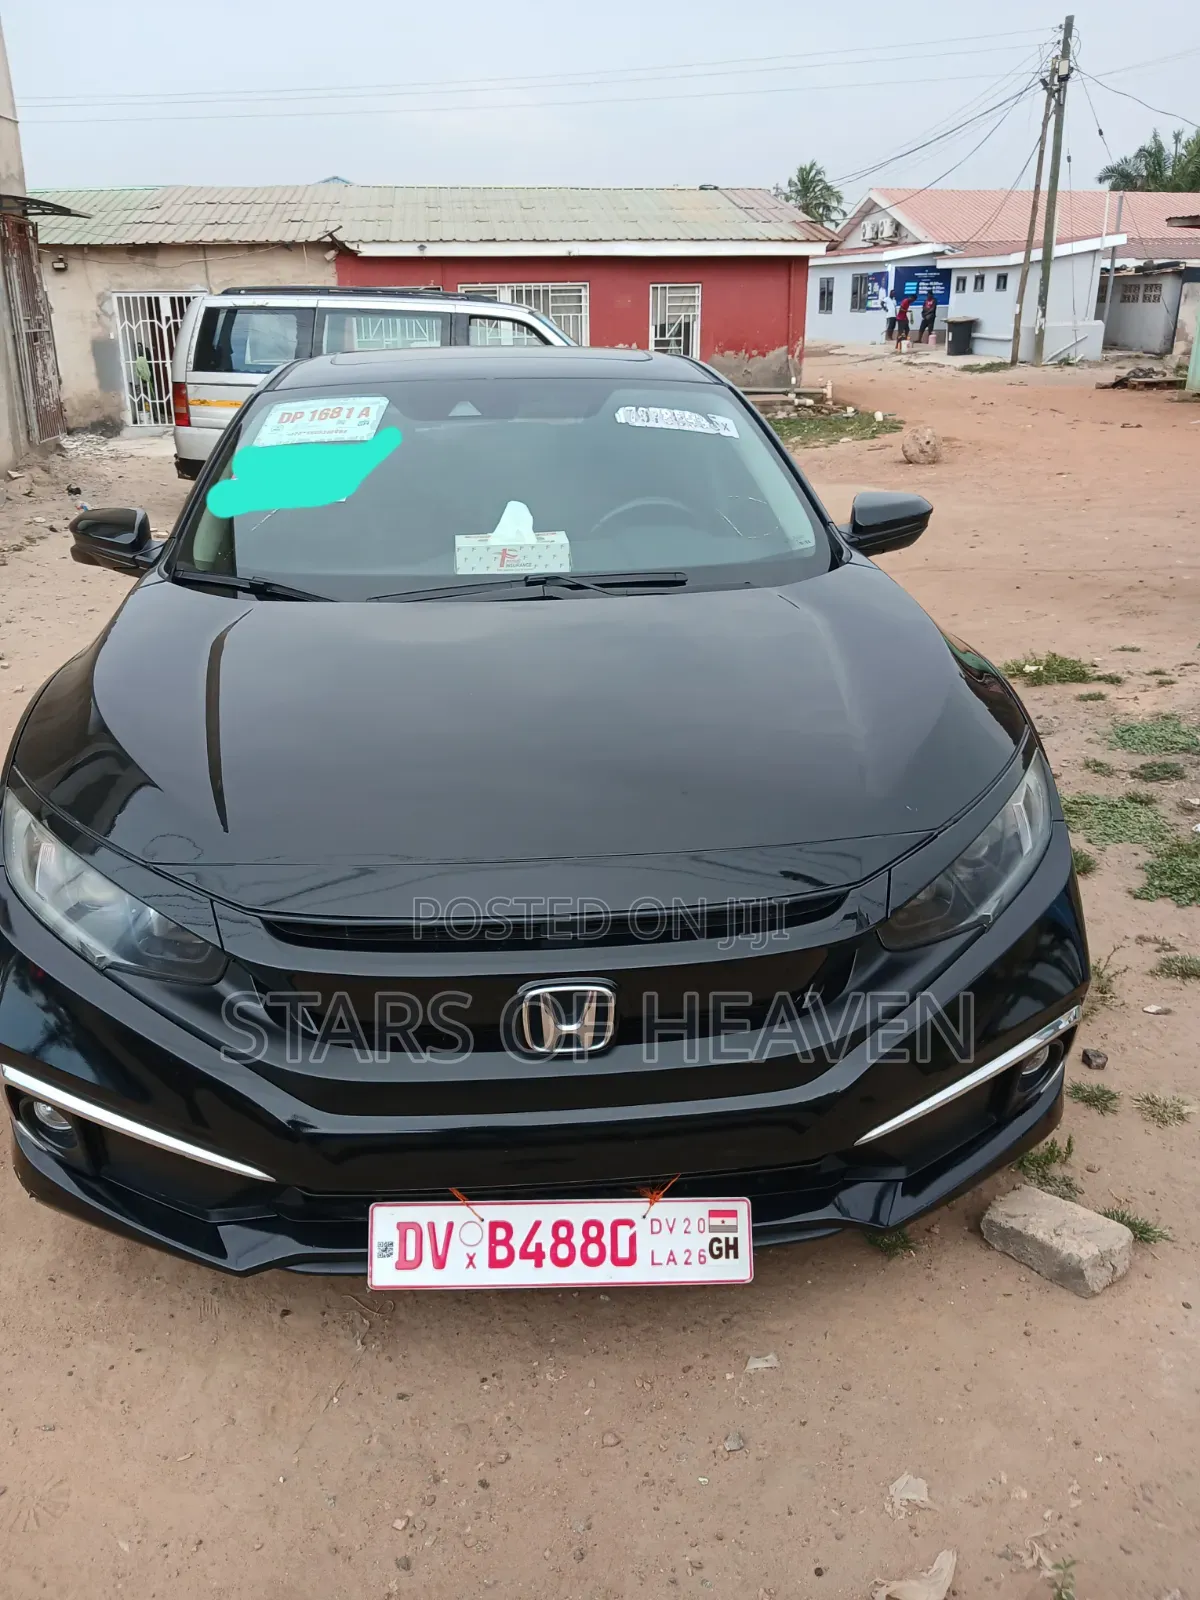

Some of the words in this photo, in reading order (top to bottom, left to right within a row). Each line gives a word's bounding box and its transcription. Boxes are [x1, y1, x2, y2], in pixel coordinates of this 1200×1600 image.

[278, 411, 304, 424] DP
[309, 406, 355, 422] 1681
[357, 407, 370, 419] A
[395, 1221, 455, 1270] DV
[708, 1236, 740, 1260] GH
